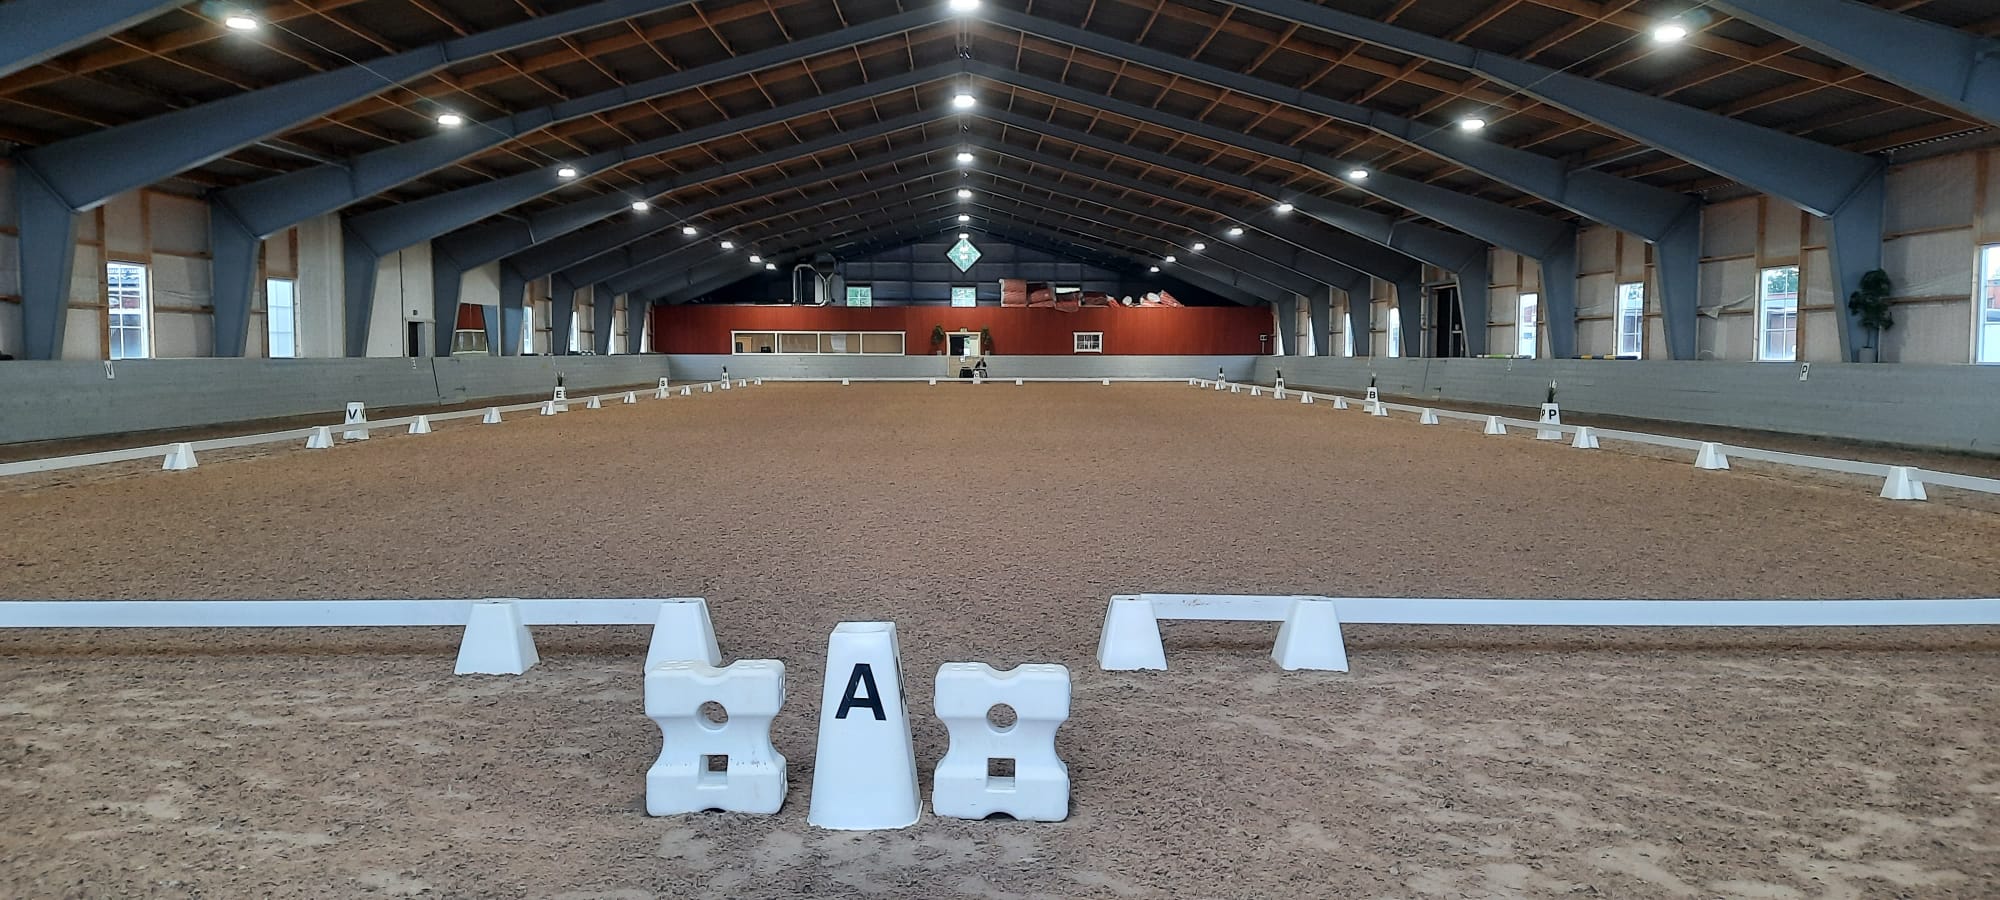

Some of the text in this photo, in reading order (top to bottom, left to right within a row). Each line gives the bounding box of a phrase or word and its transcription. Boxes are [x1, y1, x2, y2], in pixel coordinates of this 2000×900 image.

[1801, 365, 1808, 377] P
[348, 409, 357, 419] V
[1549, 409, 1557, 420] P
[835, 663, 887, 720] A
